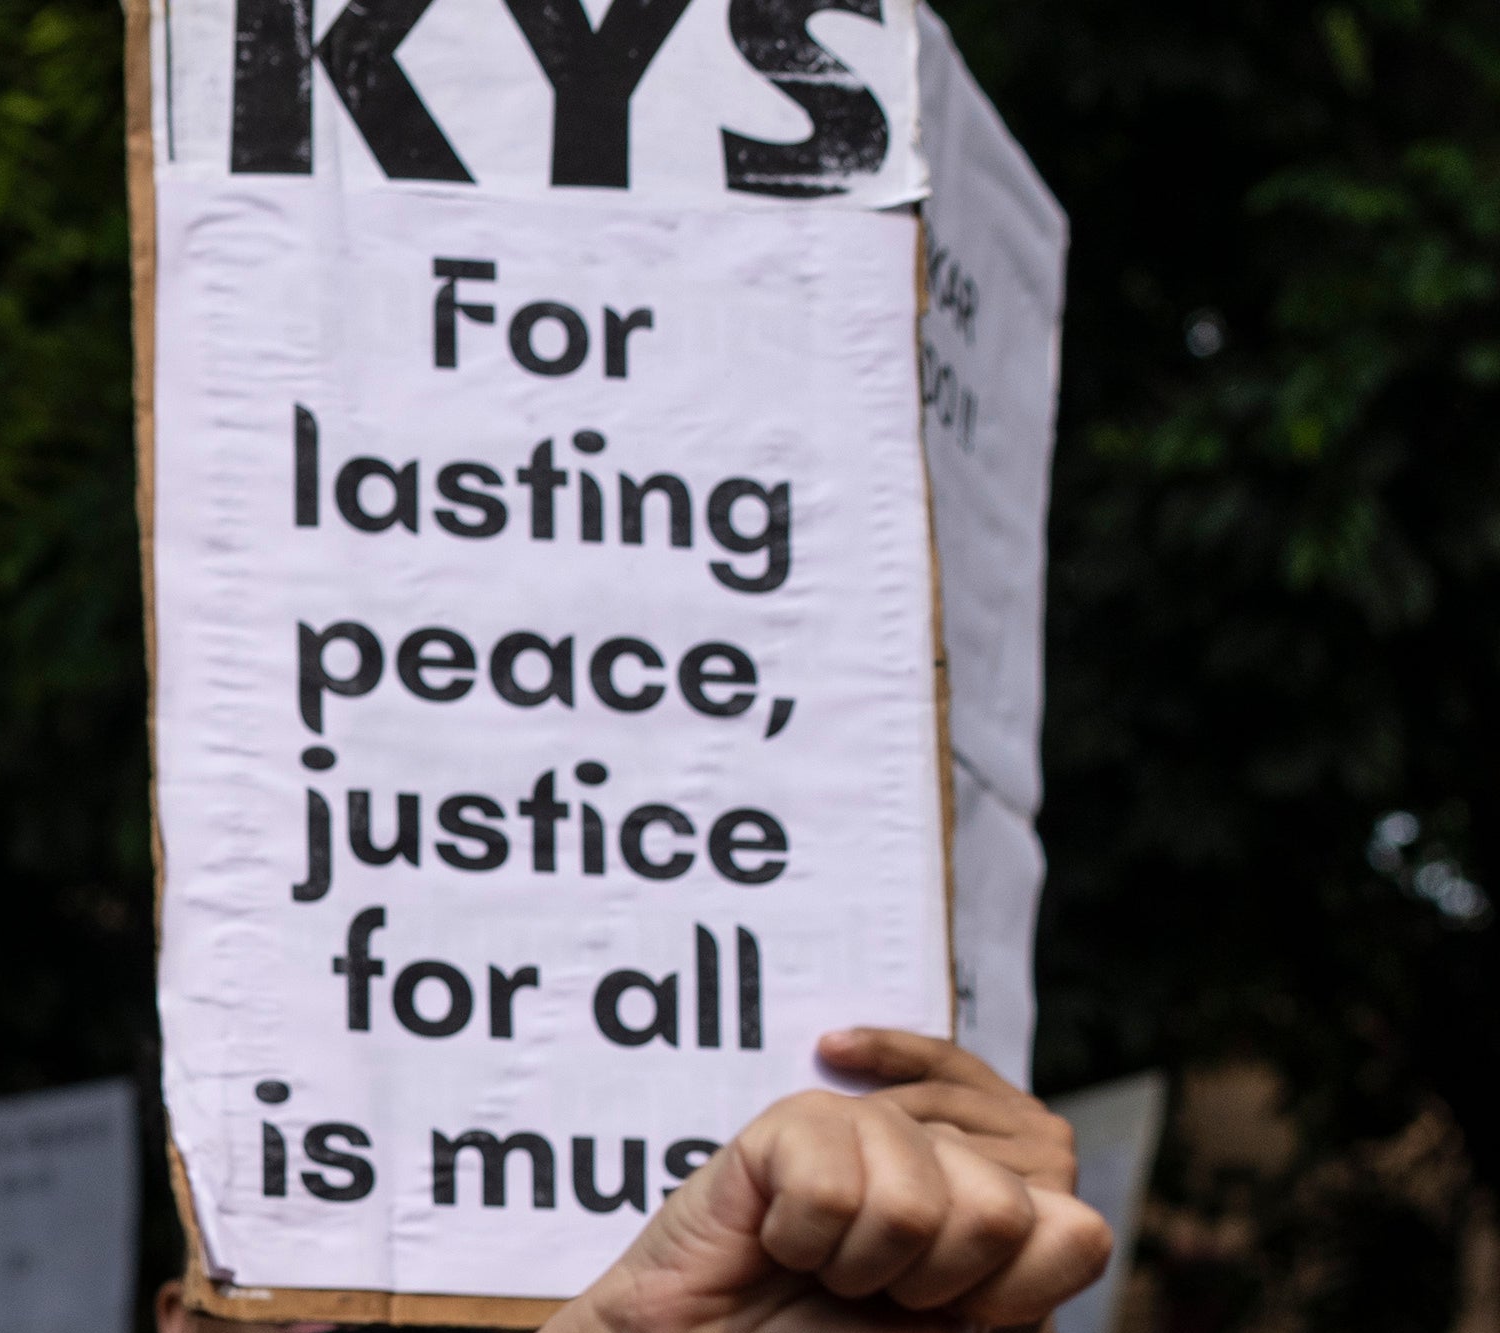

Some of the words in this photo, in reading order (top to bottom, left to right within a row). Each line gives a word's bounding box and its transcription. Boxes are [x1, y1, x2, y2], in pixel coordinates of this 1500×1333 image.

[230, 0, 890, 198] KYS
[432, 258, 654, 380] For
[292, 403, 794, 595] lasting
[295, 618, 798, 740] peace,
[291, 745, 791, 903] justice
[332, 907, 540, 1040] for
[591, 922, 764, 1051] all
[255, 1080, 376, 1203] is
